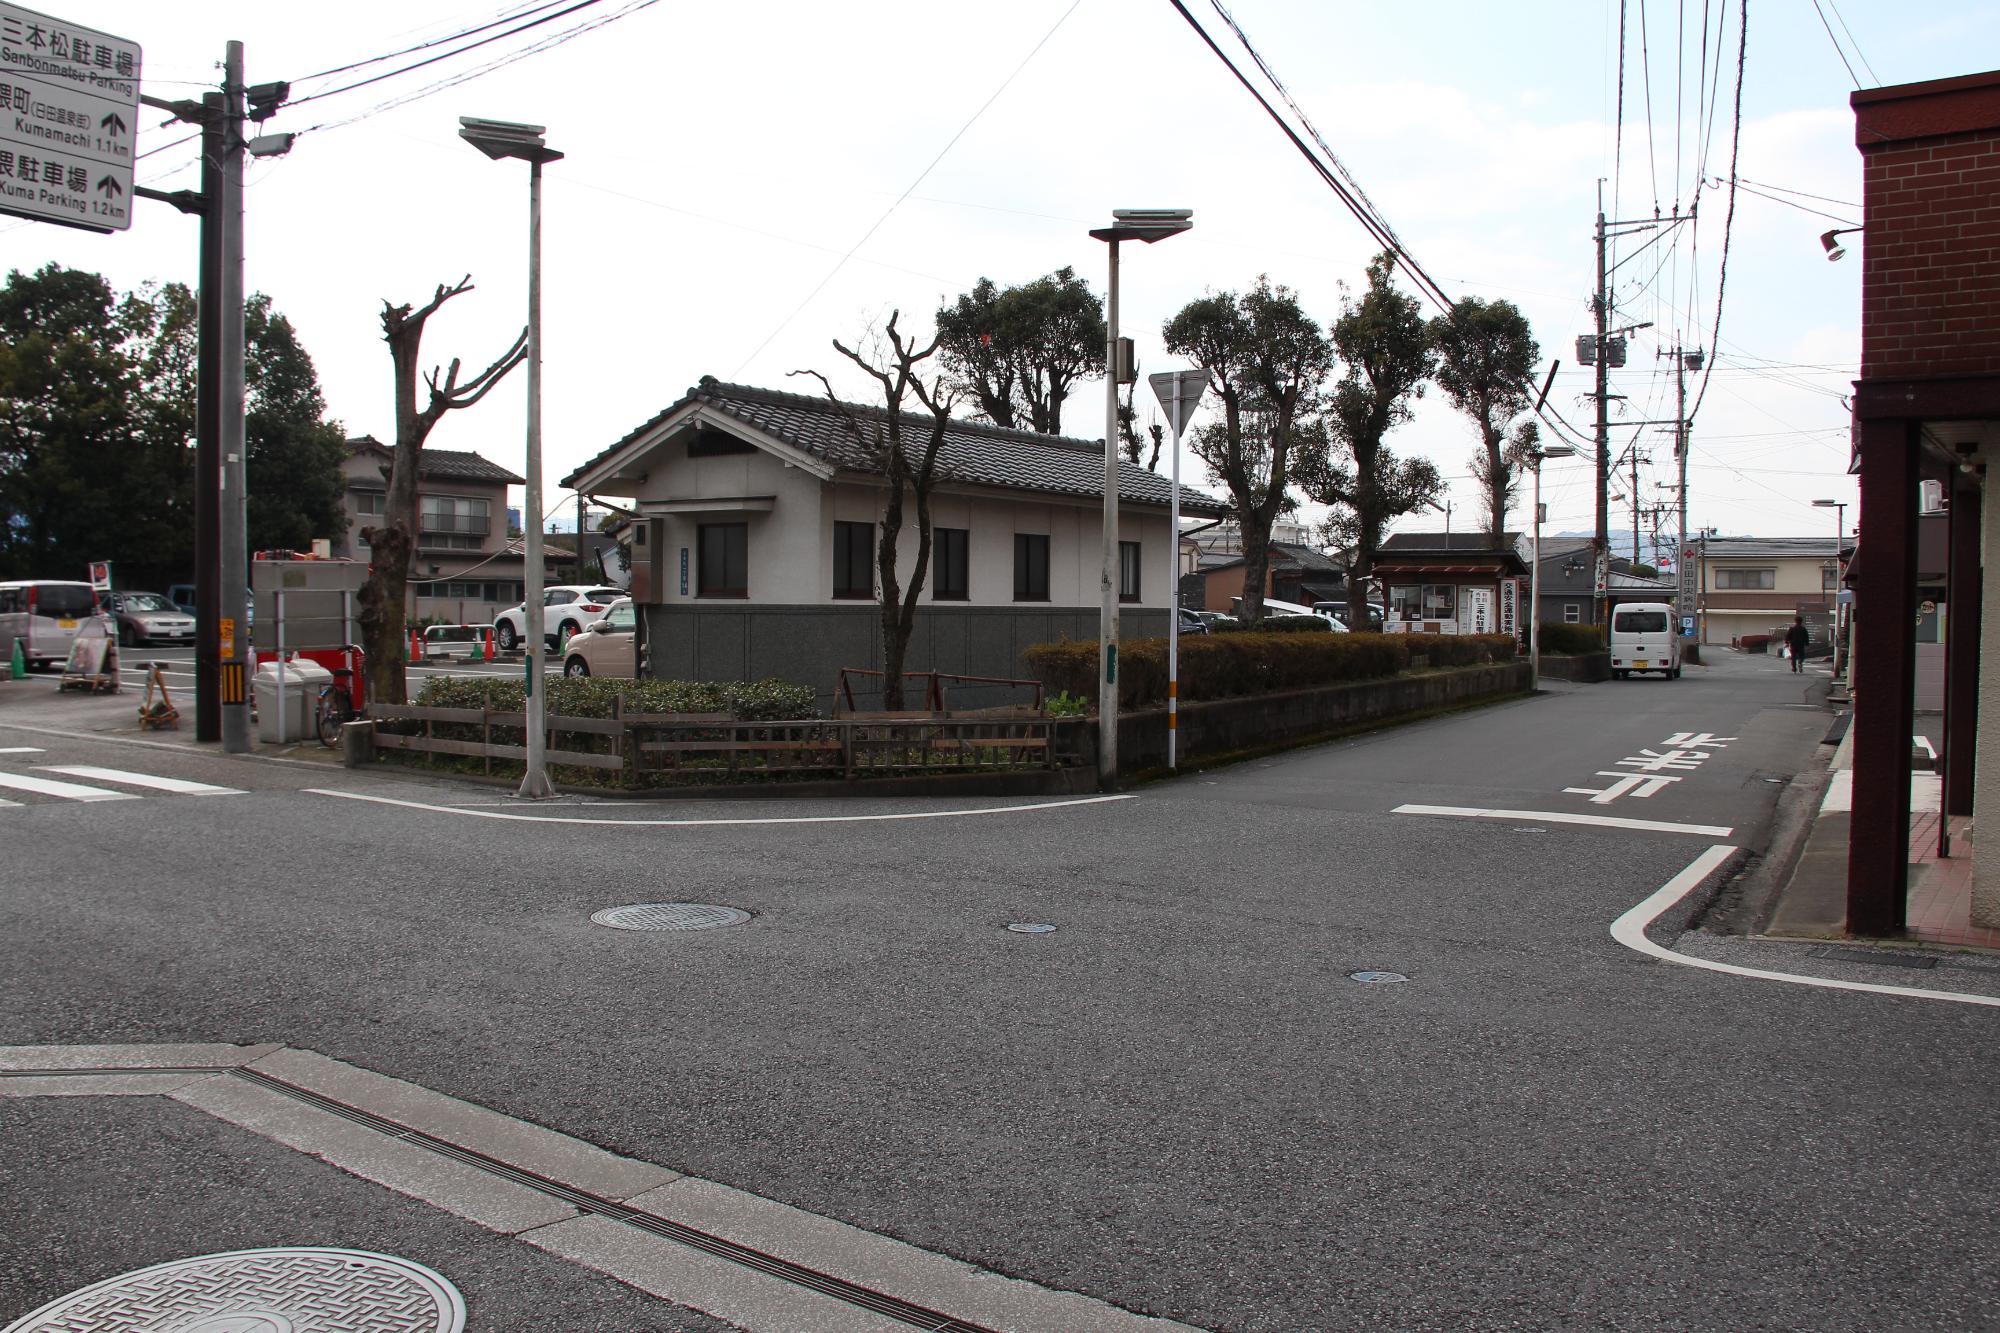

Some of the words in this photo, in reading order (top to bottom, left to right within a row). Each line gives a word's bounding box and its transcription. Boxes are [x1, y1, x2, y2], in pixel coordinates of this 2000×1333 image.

[1, 16, 133, 78] 三本松駐車場
[2, 46, 85, 82] Sanbonmatsu
[89, 72, 132, 97] Parking
[15, 117, 91, 148] Kumamachi
[0, 180, 35, 200] Kuma
[40, 189, 87, 213] Parking
[1682, 561, 1694, 612] 日田中央病院
[1560, 732, 1739, 805] 止まれ
